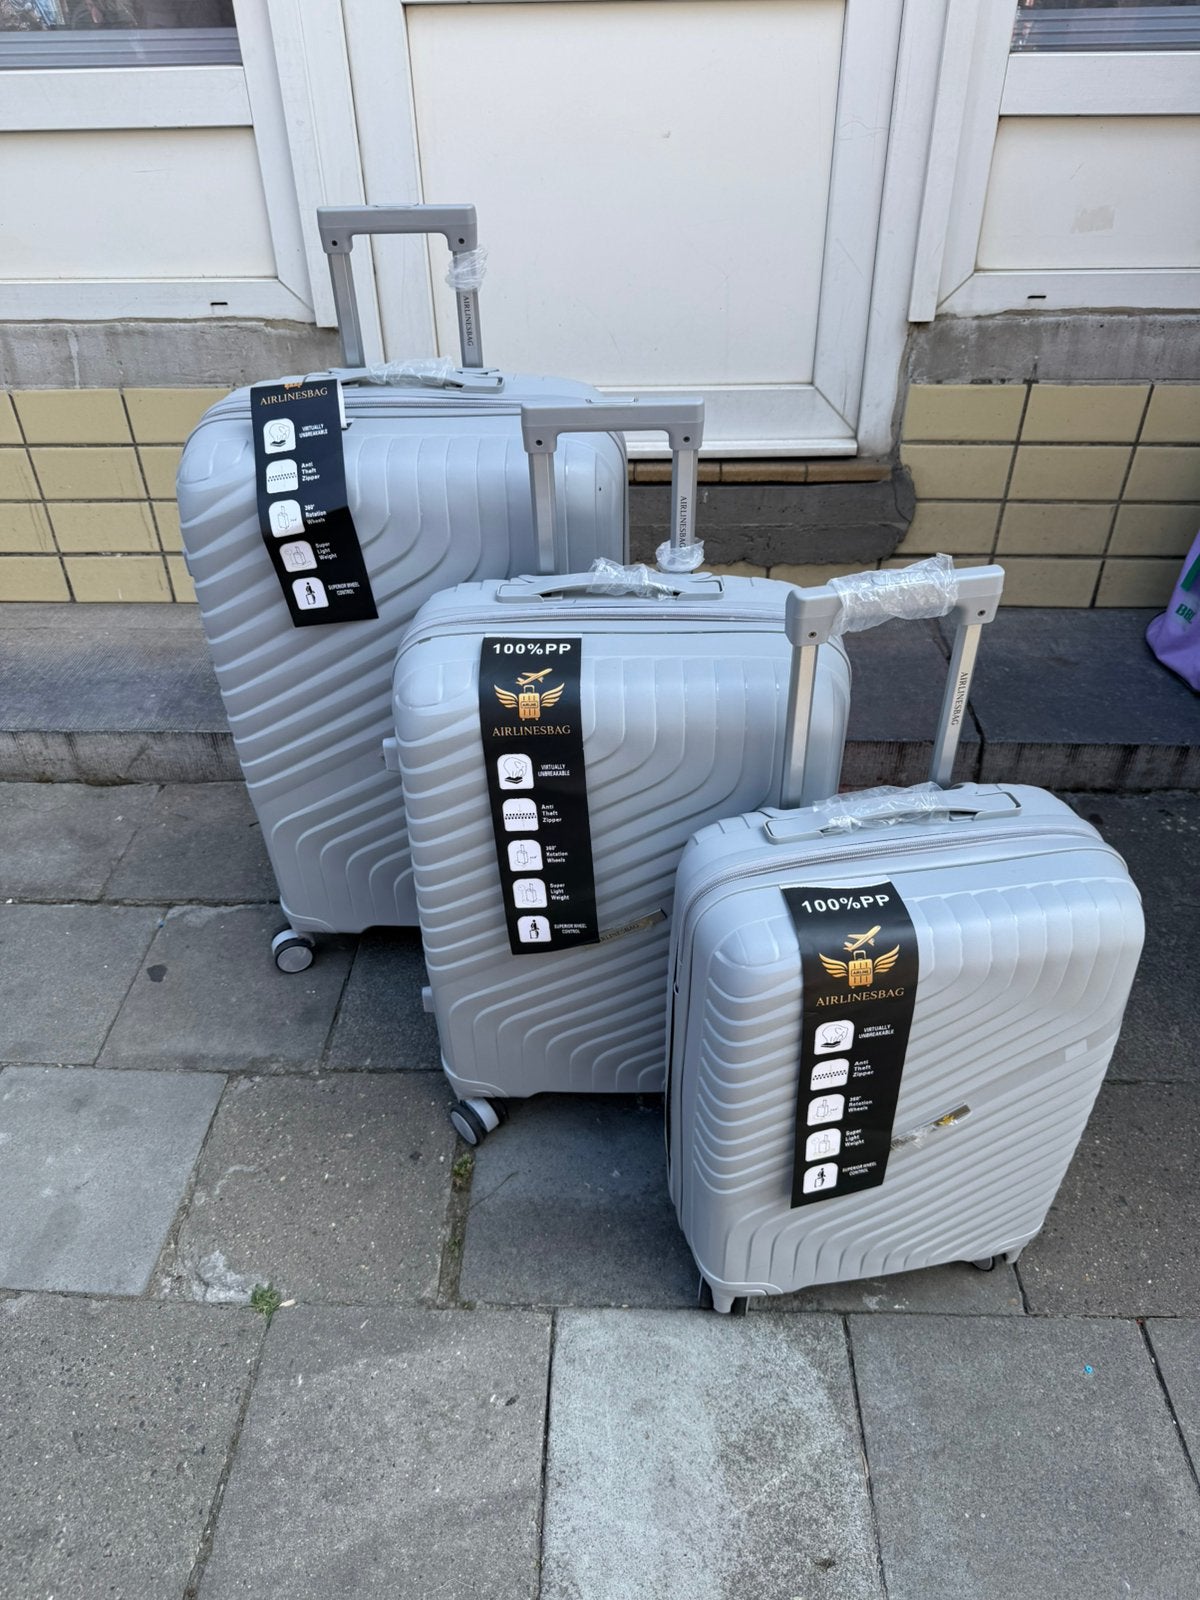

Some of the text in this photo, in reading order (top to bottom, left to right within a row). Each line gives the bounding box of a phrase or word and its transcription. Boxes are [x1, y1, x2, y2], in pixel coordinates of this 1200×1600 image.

[463, 295, 474, 347] AIRLINESBAG
[260, 387, 328, 406] AIRLINESBAG
[302, 424, 324, 432] VIRTUALLY
[302, 474, 320, 482] Zipper
[305, 510, 327, 518] Rotation
[493, 643, 571, 655] 100%PP
[951, 671, 968, 726] AIRLINESBAG
[492, 725, 571, 737] AIRLINESBAG
[801, 894, 890, 914] 100%PP
[815, 987, 905, 1007] AIRLINESBAG
[863, 1024, 891, 1033] VIRTUALLY
[852, 1070, 874, 1078] Zipper
[844, 1139, 865, 1147] Weight
